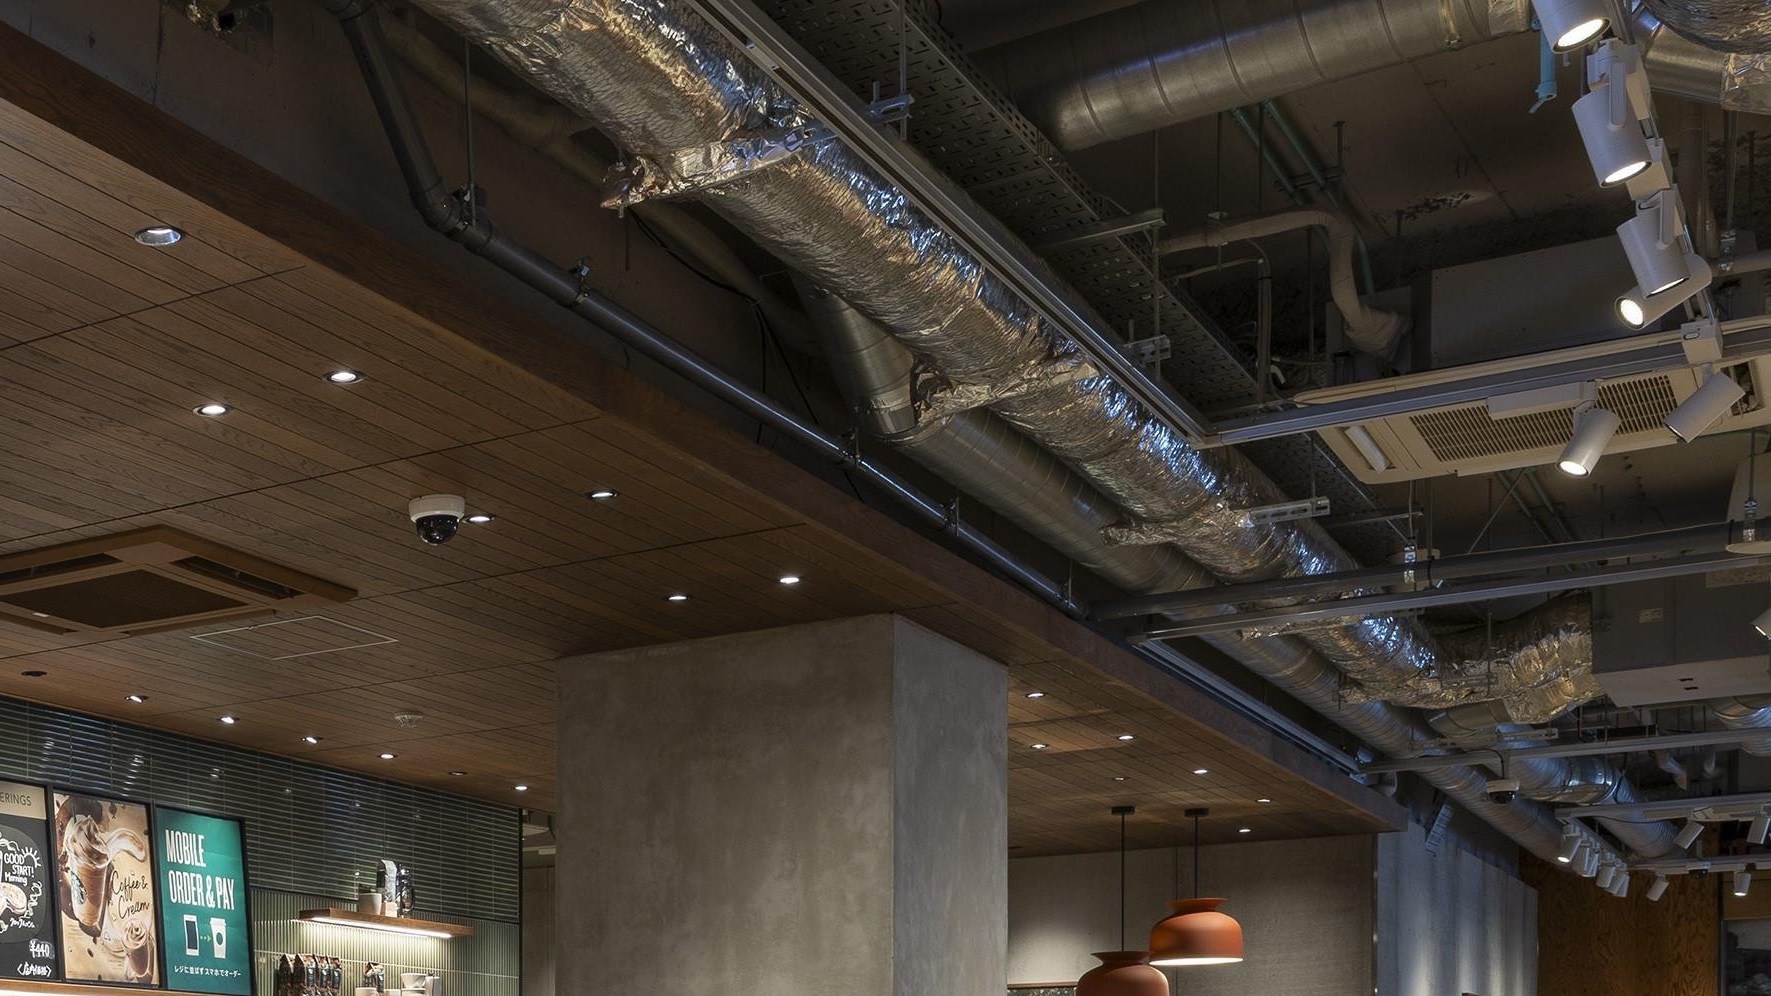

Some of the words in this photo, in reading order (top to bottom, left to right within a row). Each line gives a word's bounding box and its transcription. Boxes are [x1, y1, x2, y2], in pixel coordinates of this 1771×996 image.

[4, 853, 25, 865] GOOD
[165, 829, 207, 868] MOBILE
[5, 871, 28, 886] Morning
[11, 864, 35, 878] START!
[112, 871, 141, 903] Coffee
[141, 875, 149, 890] &
[168, 870, 206, 907] ORDER
[205, 875, 215, 909] &
[216, 876, 235, 911] PAY
[119, 896, 150, 920] Cream
[29, 940, 50, 958] ¥440
